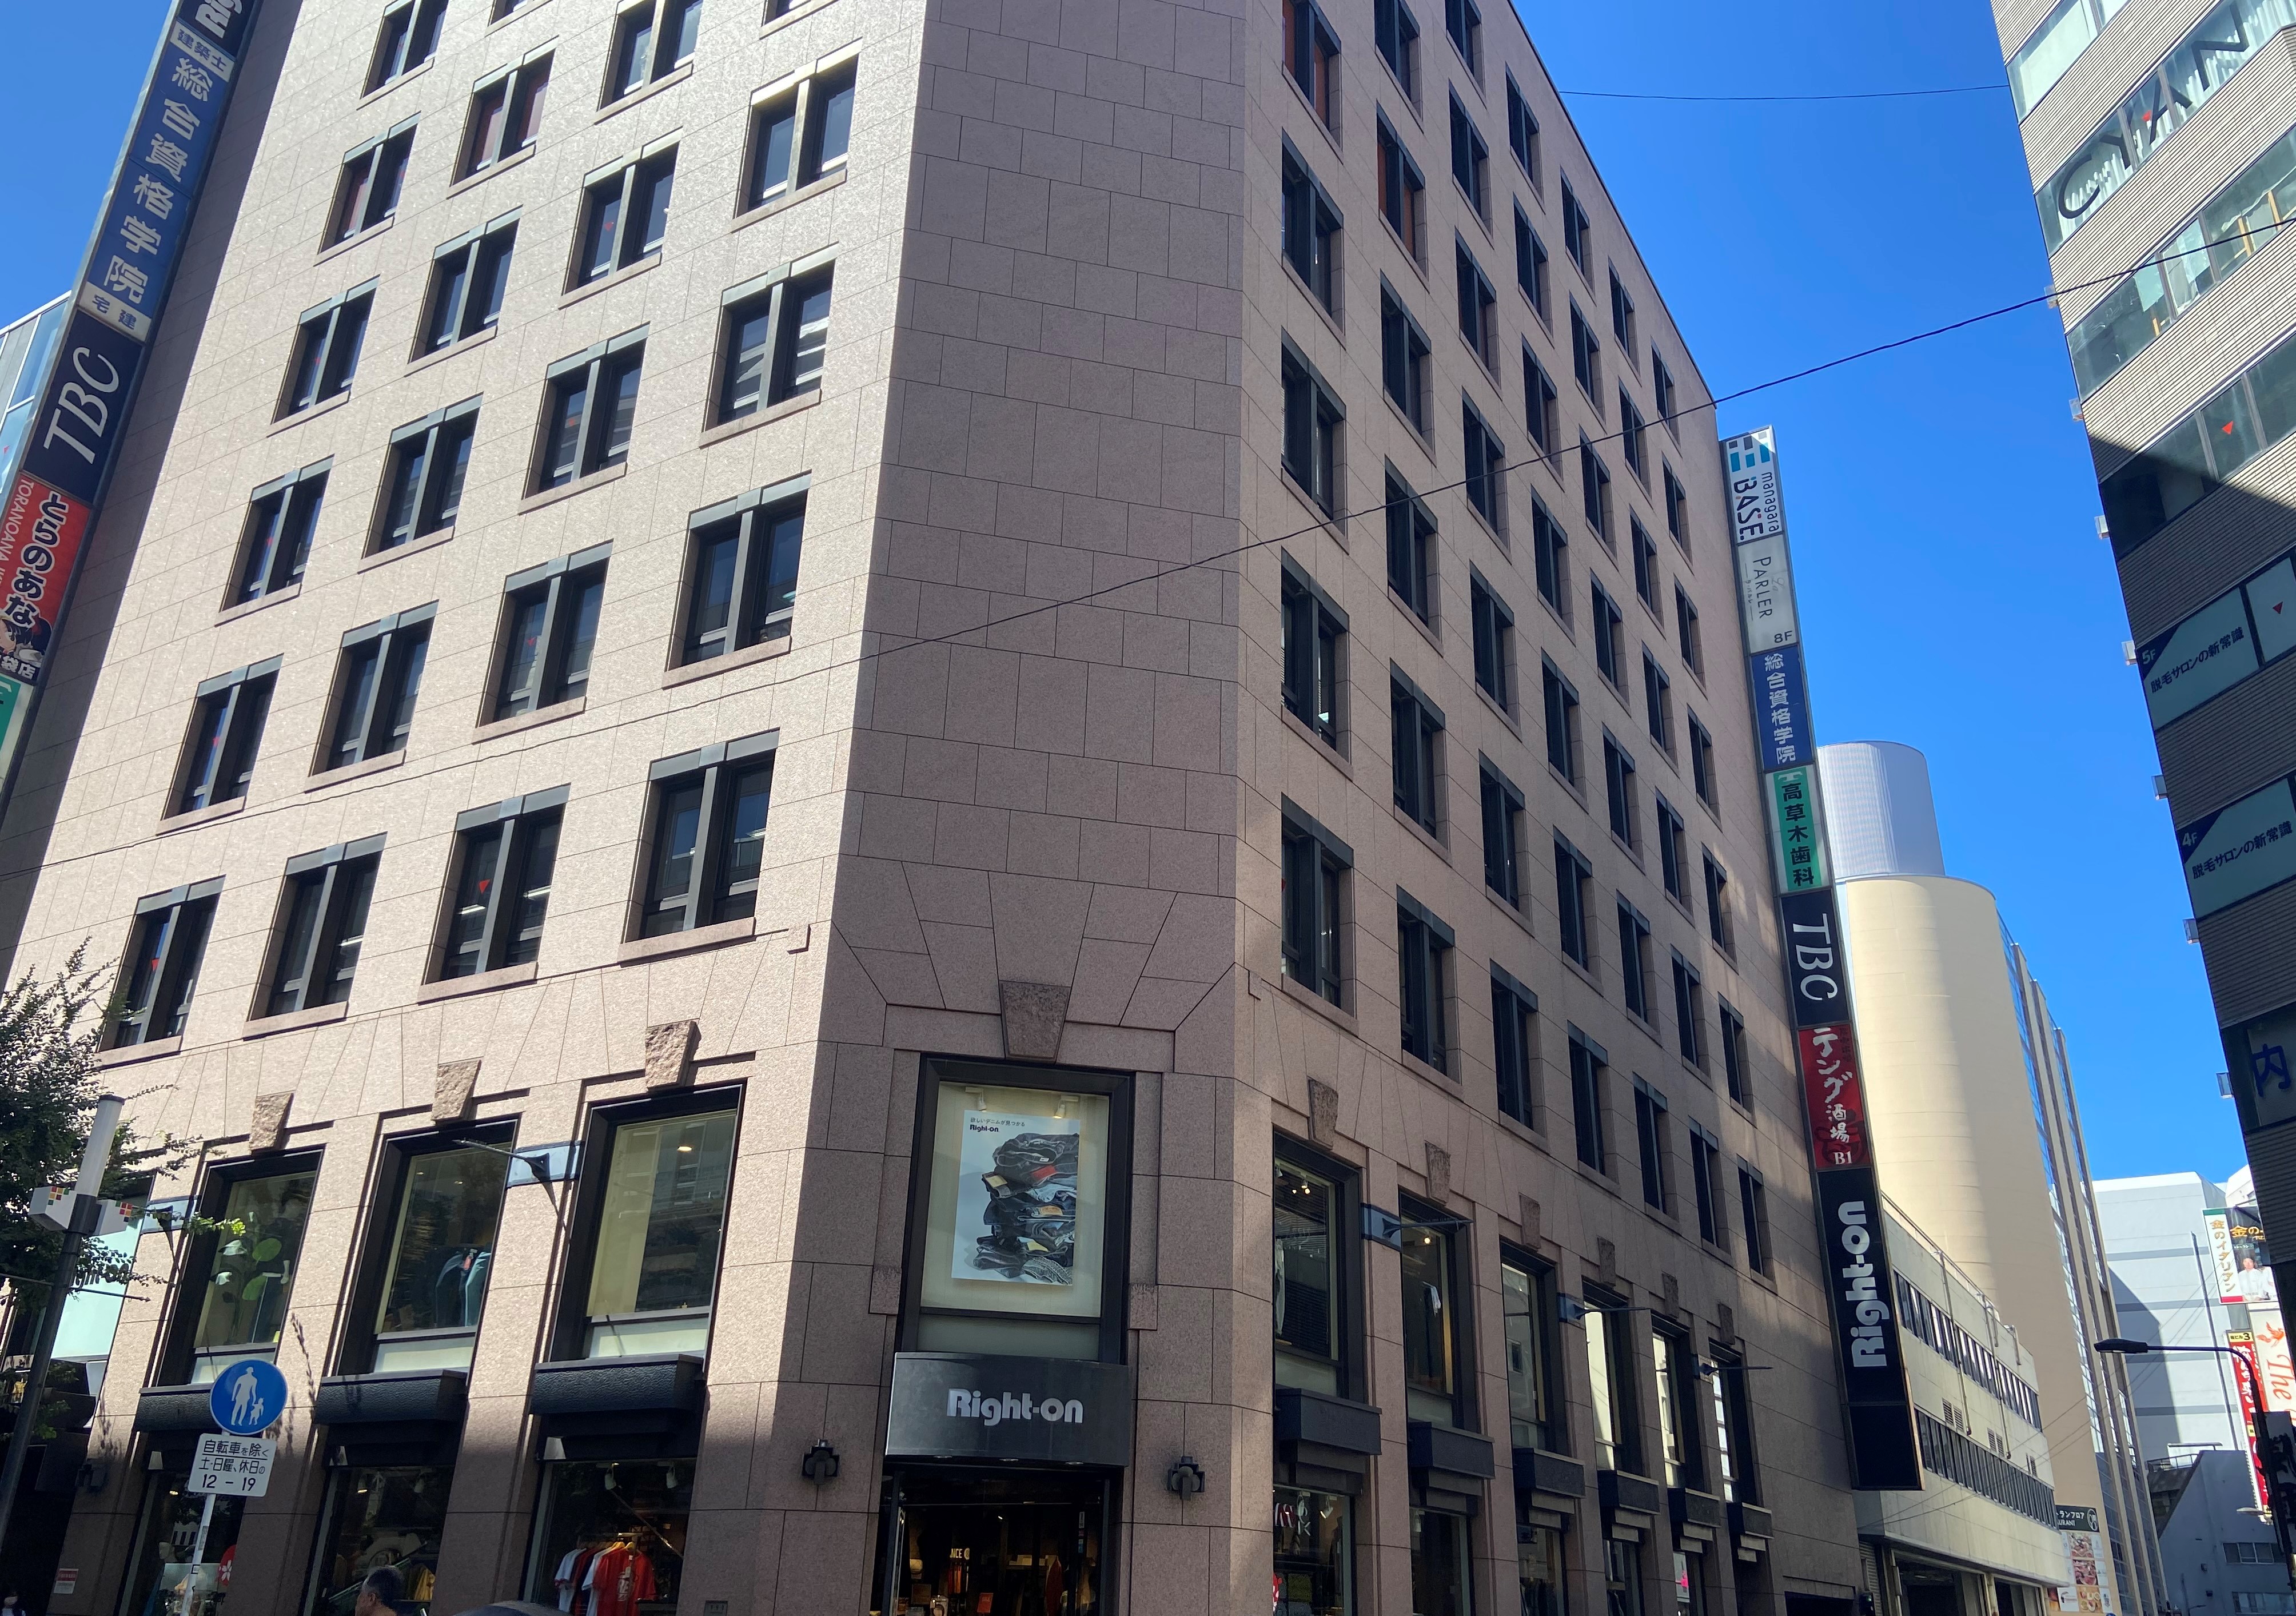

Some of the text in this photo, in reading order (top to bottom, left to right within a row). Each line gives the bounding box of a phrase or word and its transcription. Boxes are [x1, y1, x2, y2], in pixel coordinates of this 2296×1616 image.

[177, 29, 227, 72] 建築士
[2059, 2, 2250, 220] CYAN
[103, 57, 214, 305] 総合資格学院
[92, 296, 137, 331] 宅建
[43, 347, 119, 464] TBC
[1761, 472, 1780, 532] managara
[5, 491, 69, 628] とらのあな
[1753, 556, 1773, 619] PARLER
[1774, 630, 1793, 644] 8F
[2142, 648, 2157, 665] 5F
[2150, 626, 2245, 694] 脱毛サロンの新常識
[0, 655, 37, 680] 袋店
[1764, 653, 1796, 765] 総合資格学院
[1781, 782, 1815, 887] 高草木歯科
[2182, 832, 2198, 847] 4F
[2191, 820, 2293, 880] 脱毛サロンの新常識
[1792, 913, 1838, 1002] TBC
[1812, 1027, 1853, 1144] テング酒場
[2251, 1043, 2292, 1098] 内
[970, 1124, 999, 1133] Right-on
[1833, 1151, 1853, 1165] B1
[2210, 1220, 2235, 1293] 金のイタリアン
[2230, 1225, 2264, 1238] 金の
[1837, 1200, 1890, 1368] Right-on
[2266, 1354, 2295, 1400] The
[946, 1388, 1084, 1426] Right-on
[204, 1439, 270, 1457] 自転車を除く
[202, 1474, 217, 1488] 12
[242, 1477, 256, 1491] 19
[2056, 1510, 2085, 1519] ランフロア
